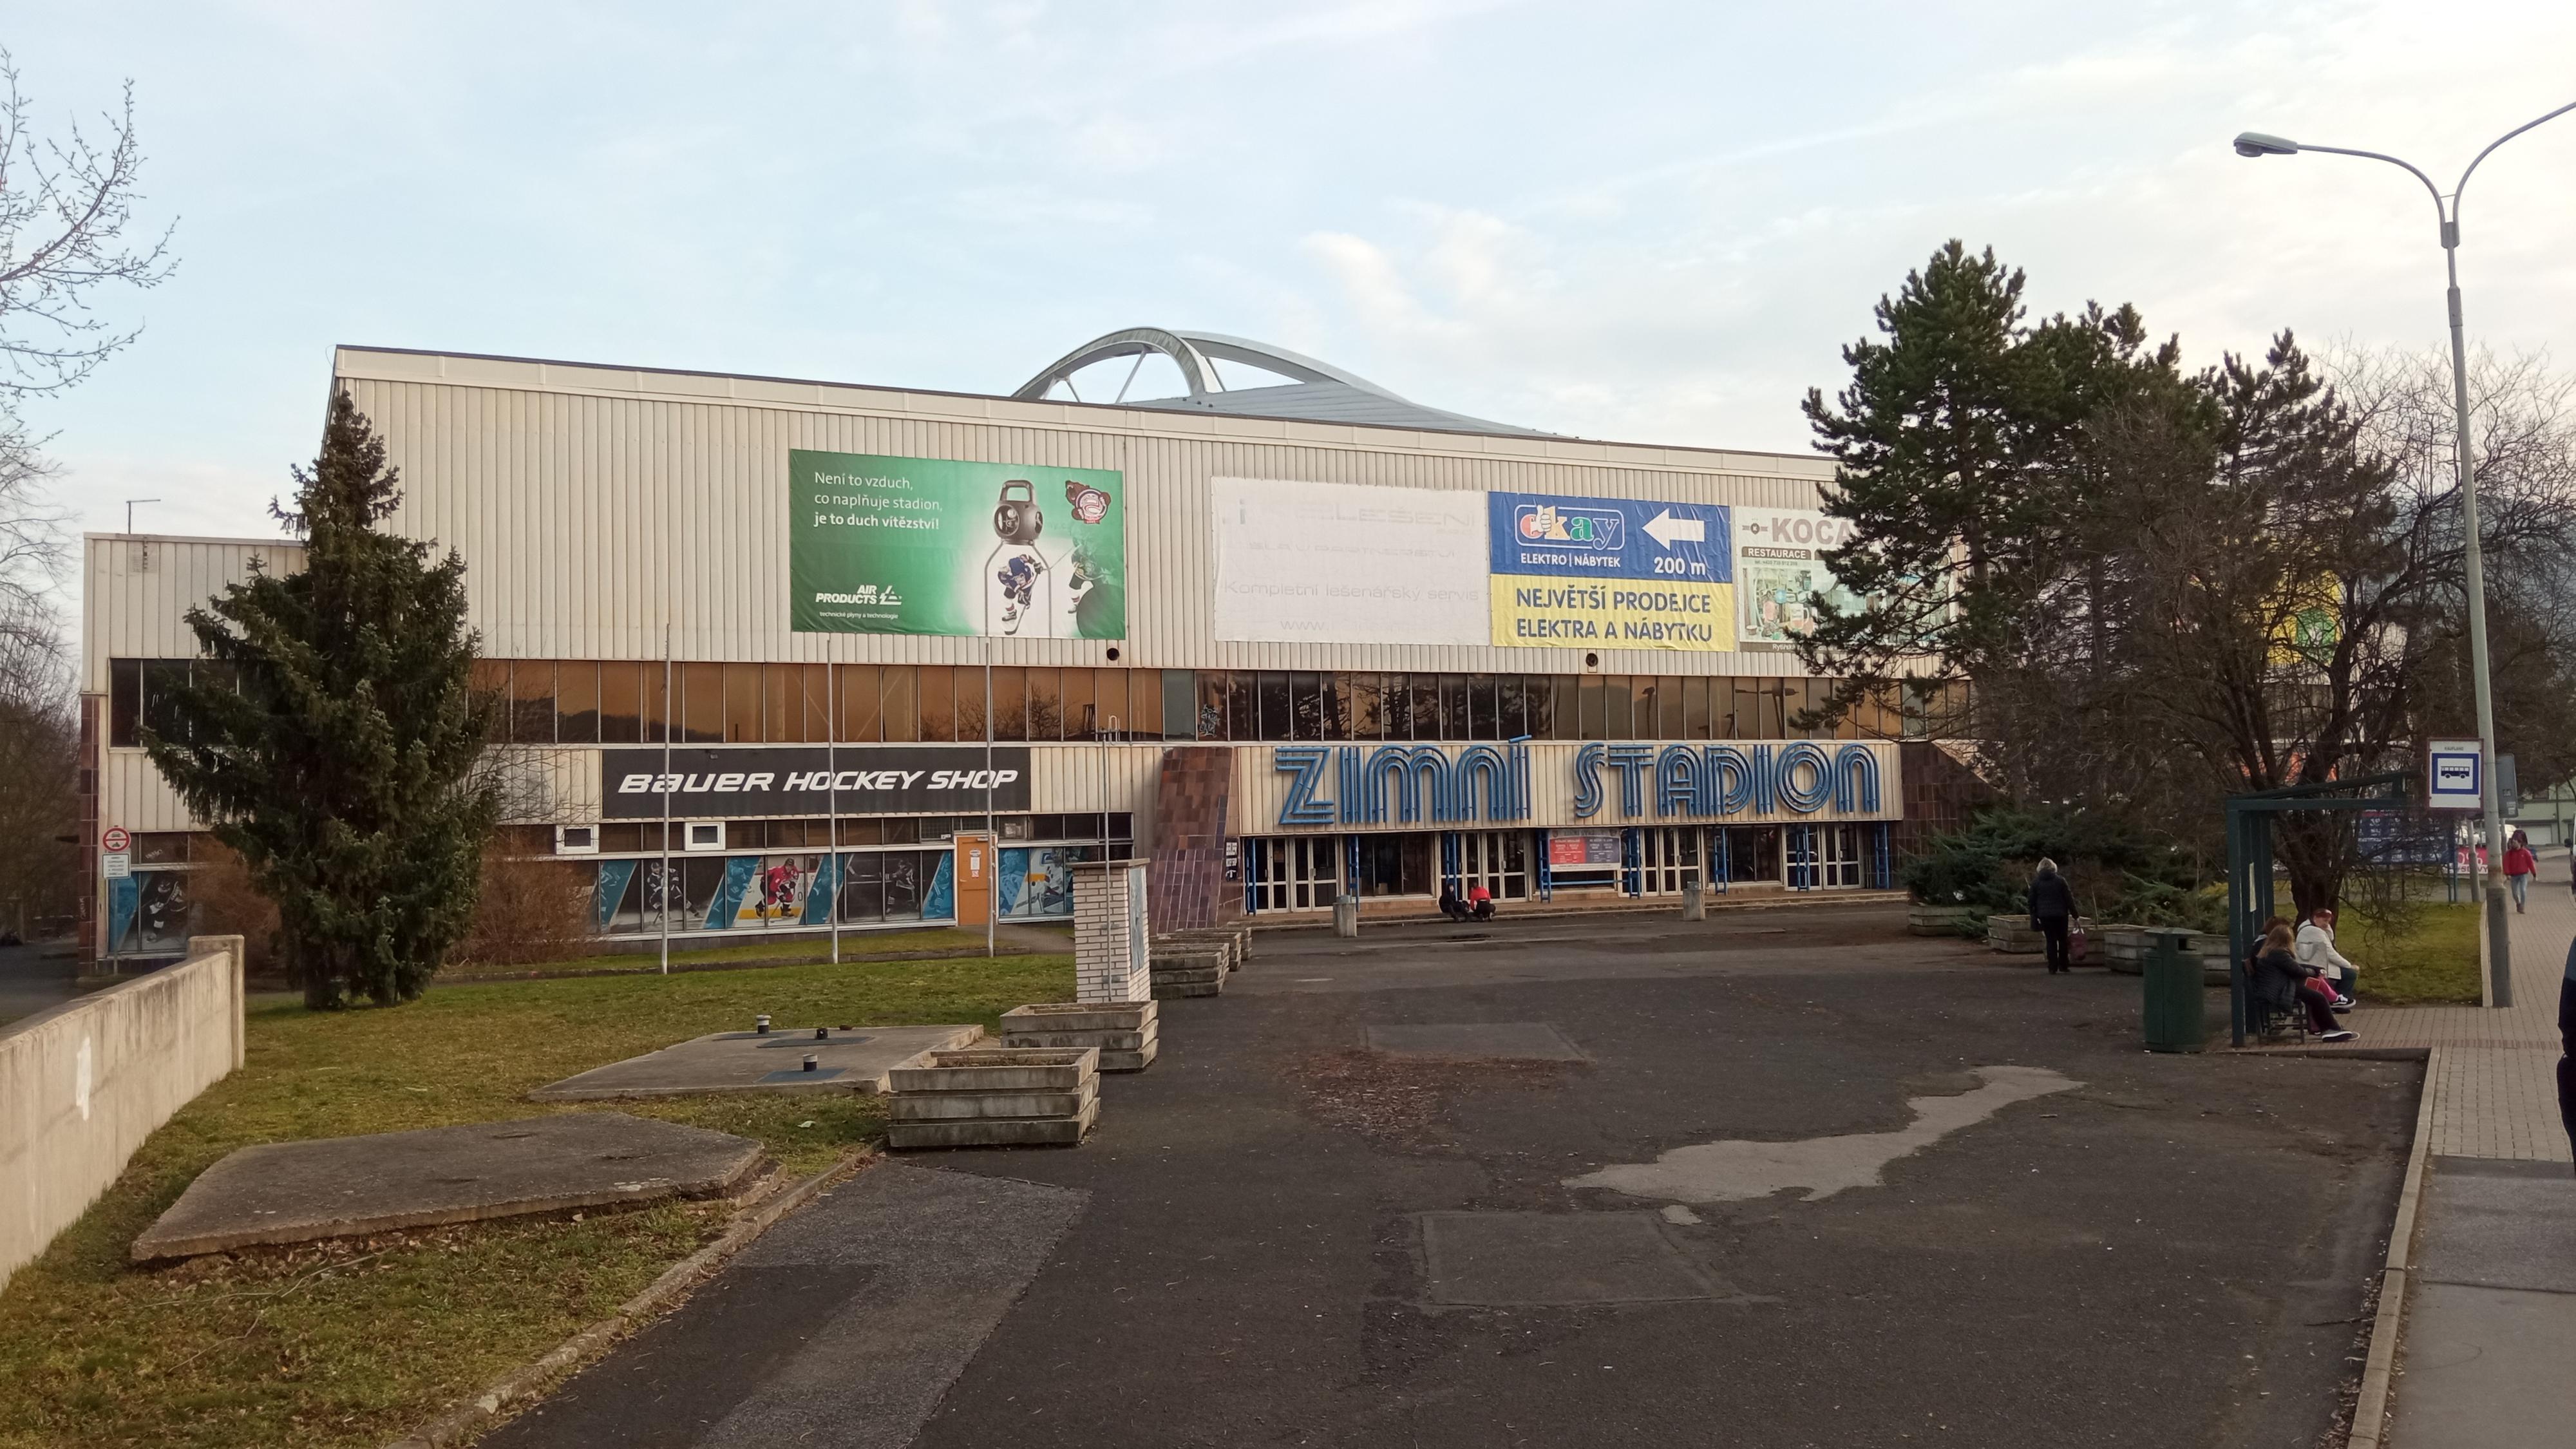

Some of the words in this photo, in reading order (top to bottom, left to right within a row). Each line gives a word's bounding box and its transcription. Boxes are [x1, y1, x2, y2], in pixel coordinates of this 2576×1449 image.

[815, 471, 845, 485] Není
[848, 474, 862, 486] to
[865, 476, 913, 490] vzduch,
[815, 494, 829, 504] co
[833, 494, 889, 510] naplňuje
[893, 498, 943, 511] stadion,
[813, 512, 827, 527] je
[829, 513, 844, 525] to
[847, 514, 878, 527] duch
[882, 515, 939, 529] vítězství!
[1772, 517, 1851, 545] KOCA
[1520, 553, 1567, 565] ELEKTRO
[1574, 553, 1621, 568] NÁBYTEK
[1748, 548, 1806, 558] RESTAURACE
[1654, 557, 1685, 574] 200
[1692, 562, 1705, 576] m
[815, 593, 877, 604] PRODUCTS
[857, 585, 877, 594] AIR
[1516, 585, 1606, 609] NEJVĚTŠÍ
[1614, 591, 1710, 613] PRODEJCE
[1517, 618, 1598, 638] ELEKTRA
[1604, 621, 1618, 639] A
[1624, 618, 1712, 642] NÁBYTKU
[783, 770, 926, 791] HOCKEY
[926, 770, 1018, 790] SHOP
[1575, 741, 1880, 818] STADION
